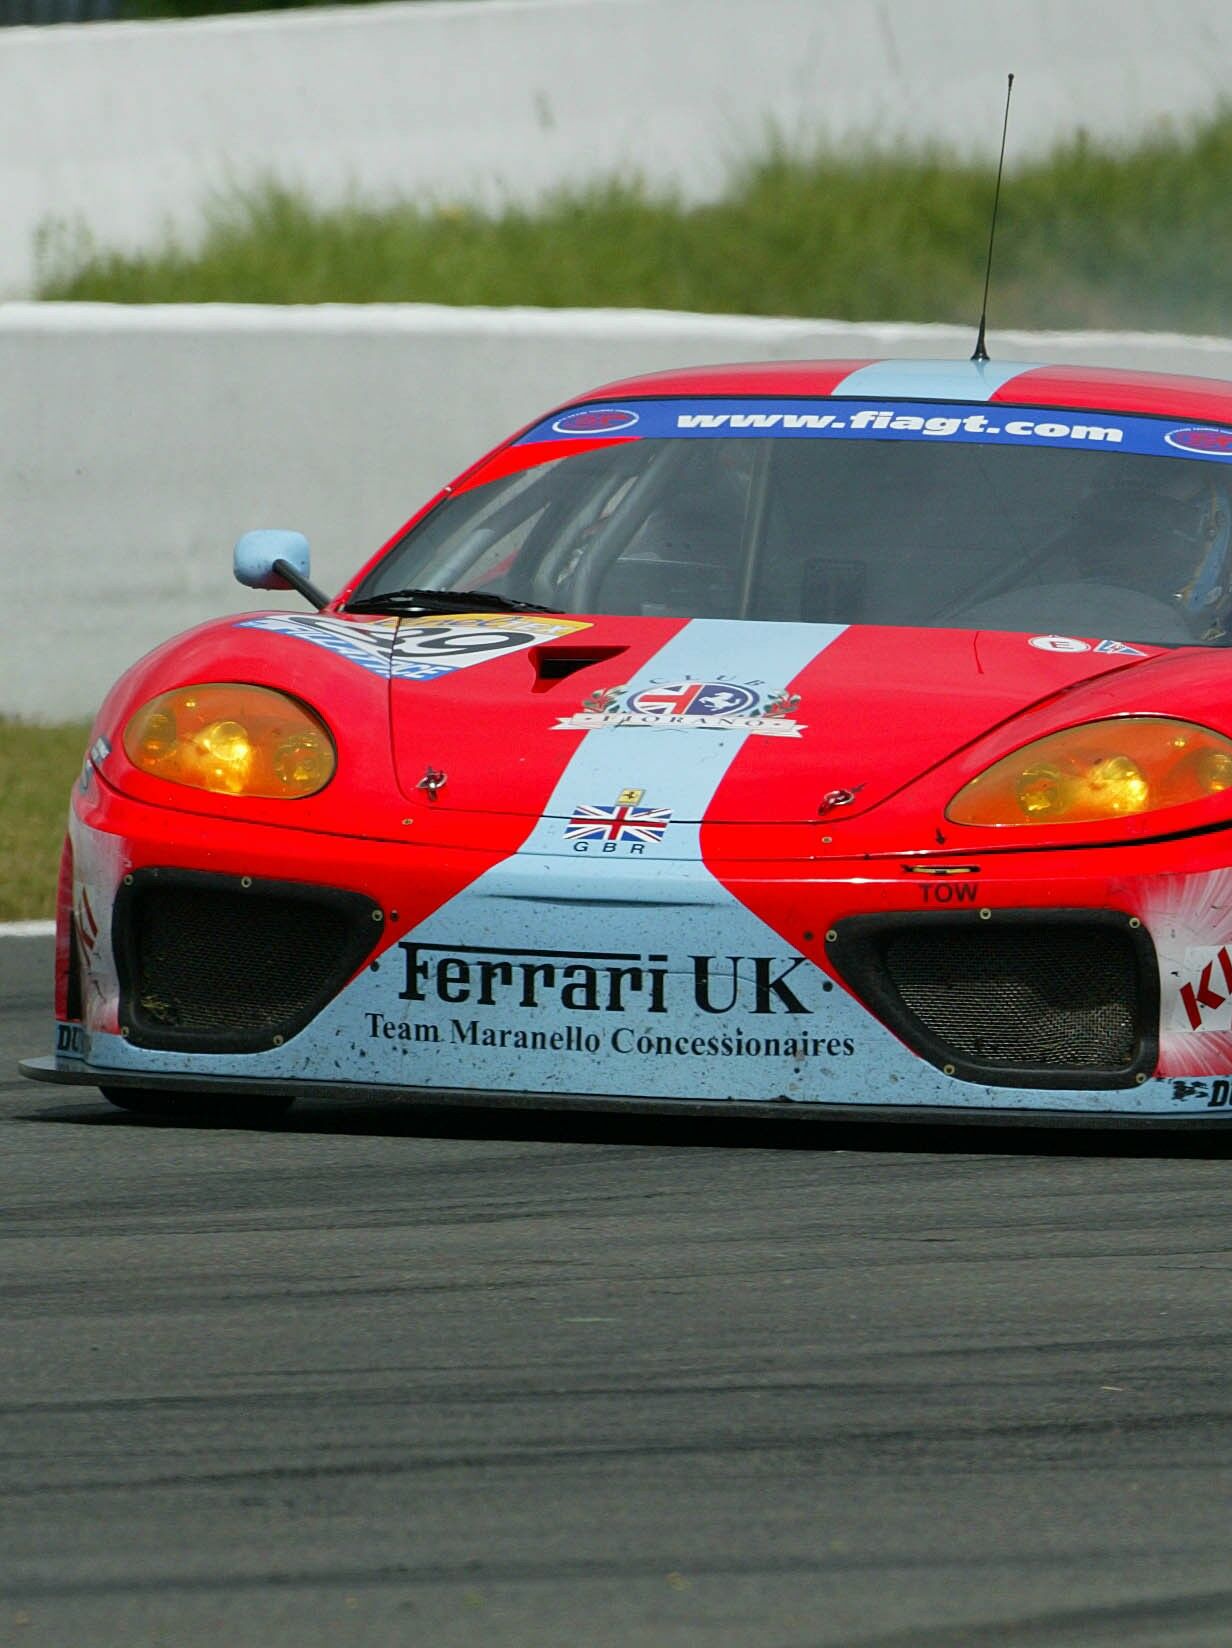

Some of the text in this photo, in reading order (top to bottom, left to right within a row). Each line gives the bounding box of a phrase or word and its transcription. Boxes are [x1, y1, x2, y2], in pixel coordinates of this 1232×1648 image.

[677, 409, 1123, 442] www.fiagt.com
[602, 715, 764, 727] FIORANO
[573, 841, 645, 855] GBR
[919, 883, 978, 902] TOW
[399, 941, 814, 1015] Ferrari UK
[365, 1013, 856, 1057] Team Maranello Concessionaires
